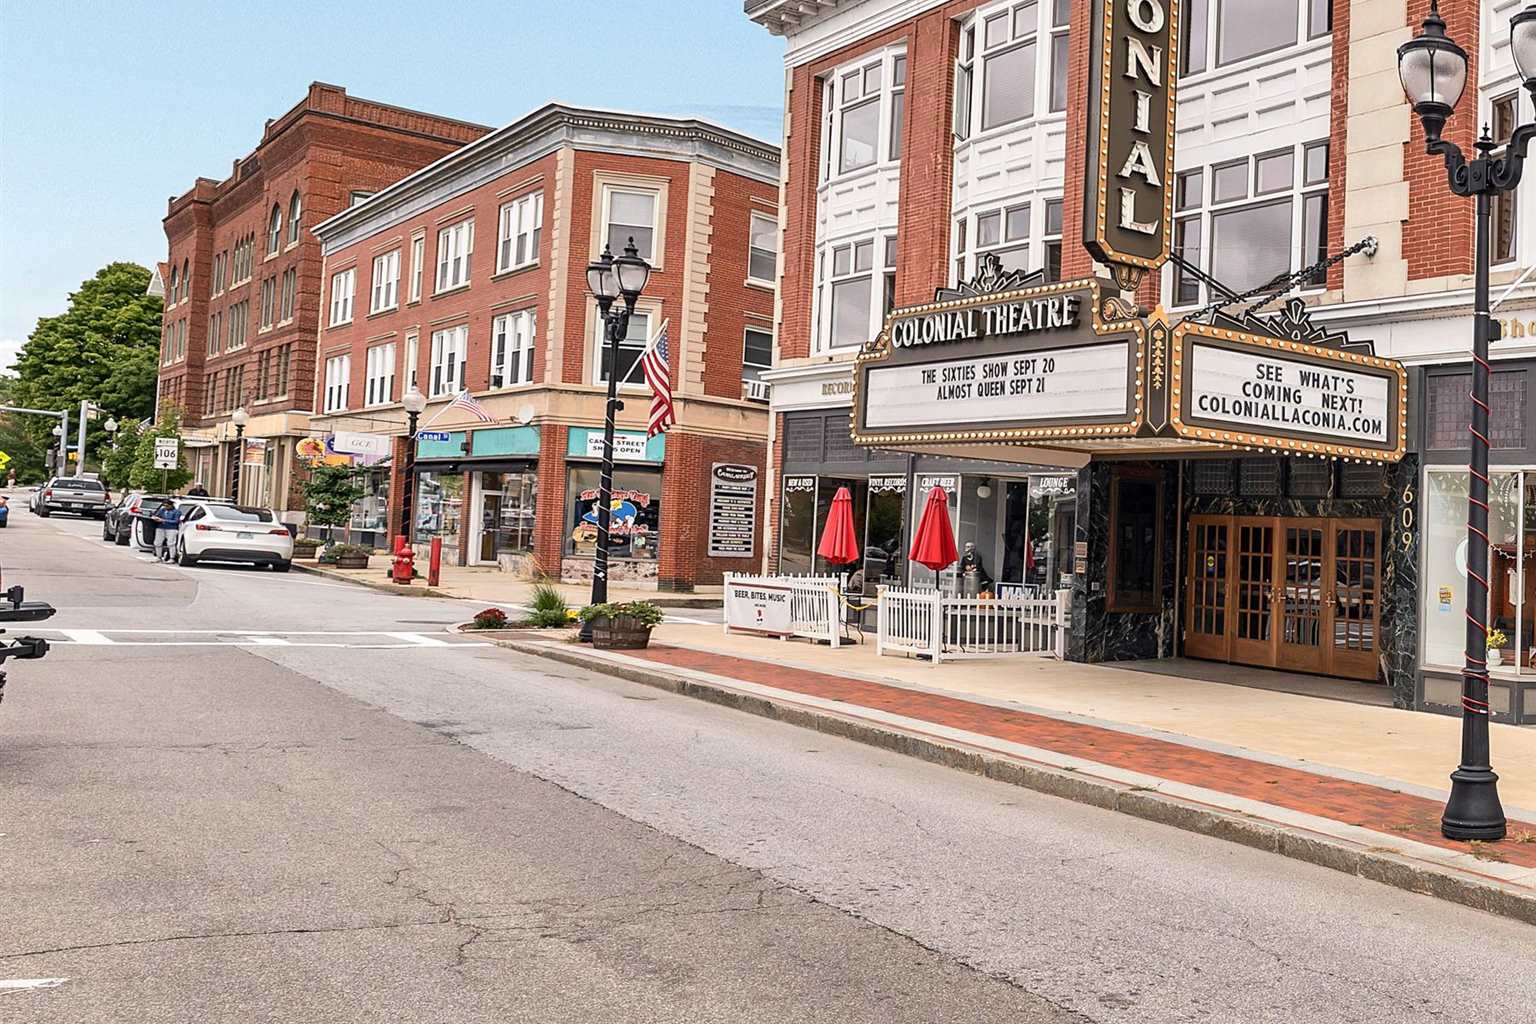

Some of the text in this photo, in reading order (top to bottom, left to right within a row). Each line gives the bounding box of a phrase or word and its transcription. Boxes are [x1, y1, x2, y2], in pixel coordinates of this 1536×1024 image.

[891, 294, 1081, 350] COLONIAL THEATRE
[921, 357, 1056, 385] THE SIXTIES SHOW SEPT 20
[1256, 363, 1355, 395] SEE WHAT'S
[821, 381, 851, 395] RECOR
[936, 377, 1046, 401] ALMOST QUEEN SEPT 21
[1241, 381, 1363, 414] COMING NEXT!
[1198, 394, 1383, 436] COLONIALLACONIA.COM
[418, 431, 441, 440] Canal
[159, 448, 176, 458] 106
[592, 445, 641, 454] SHS OPEN
[1039, 477, 1069, 488] LOUNGE
[1402, 483, 1414, 552] 609
[768, 593, 787, 603] MUSIC
